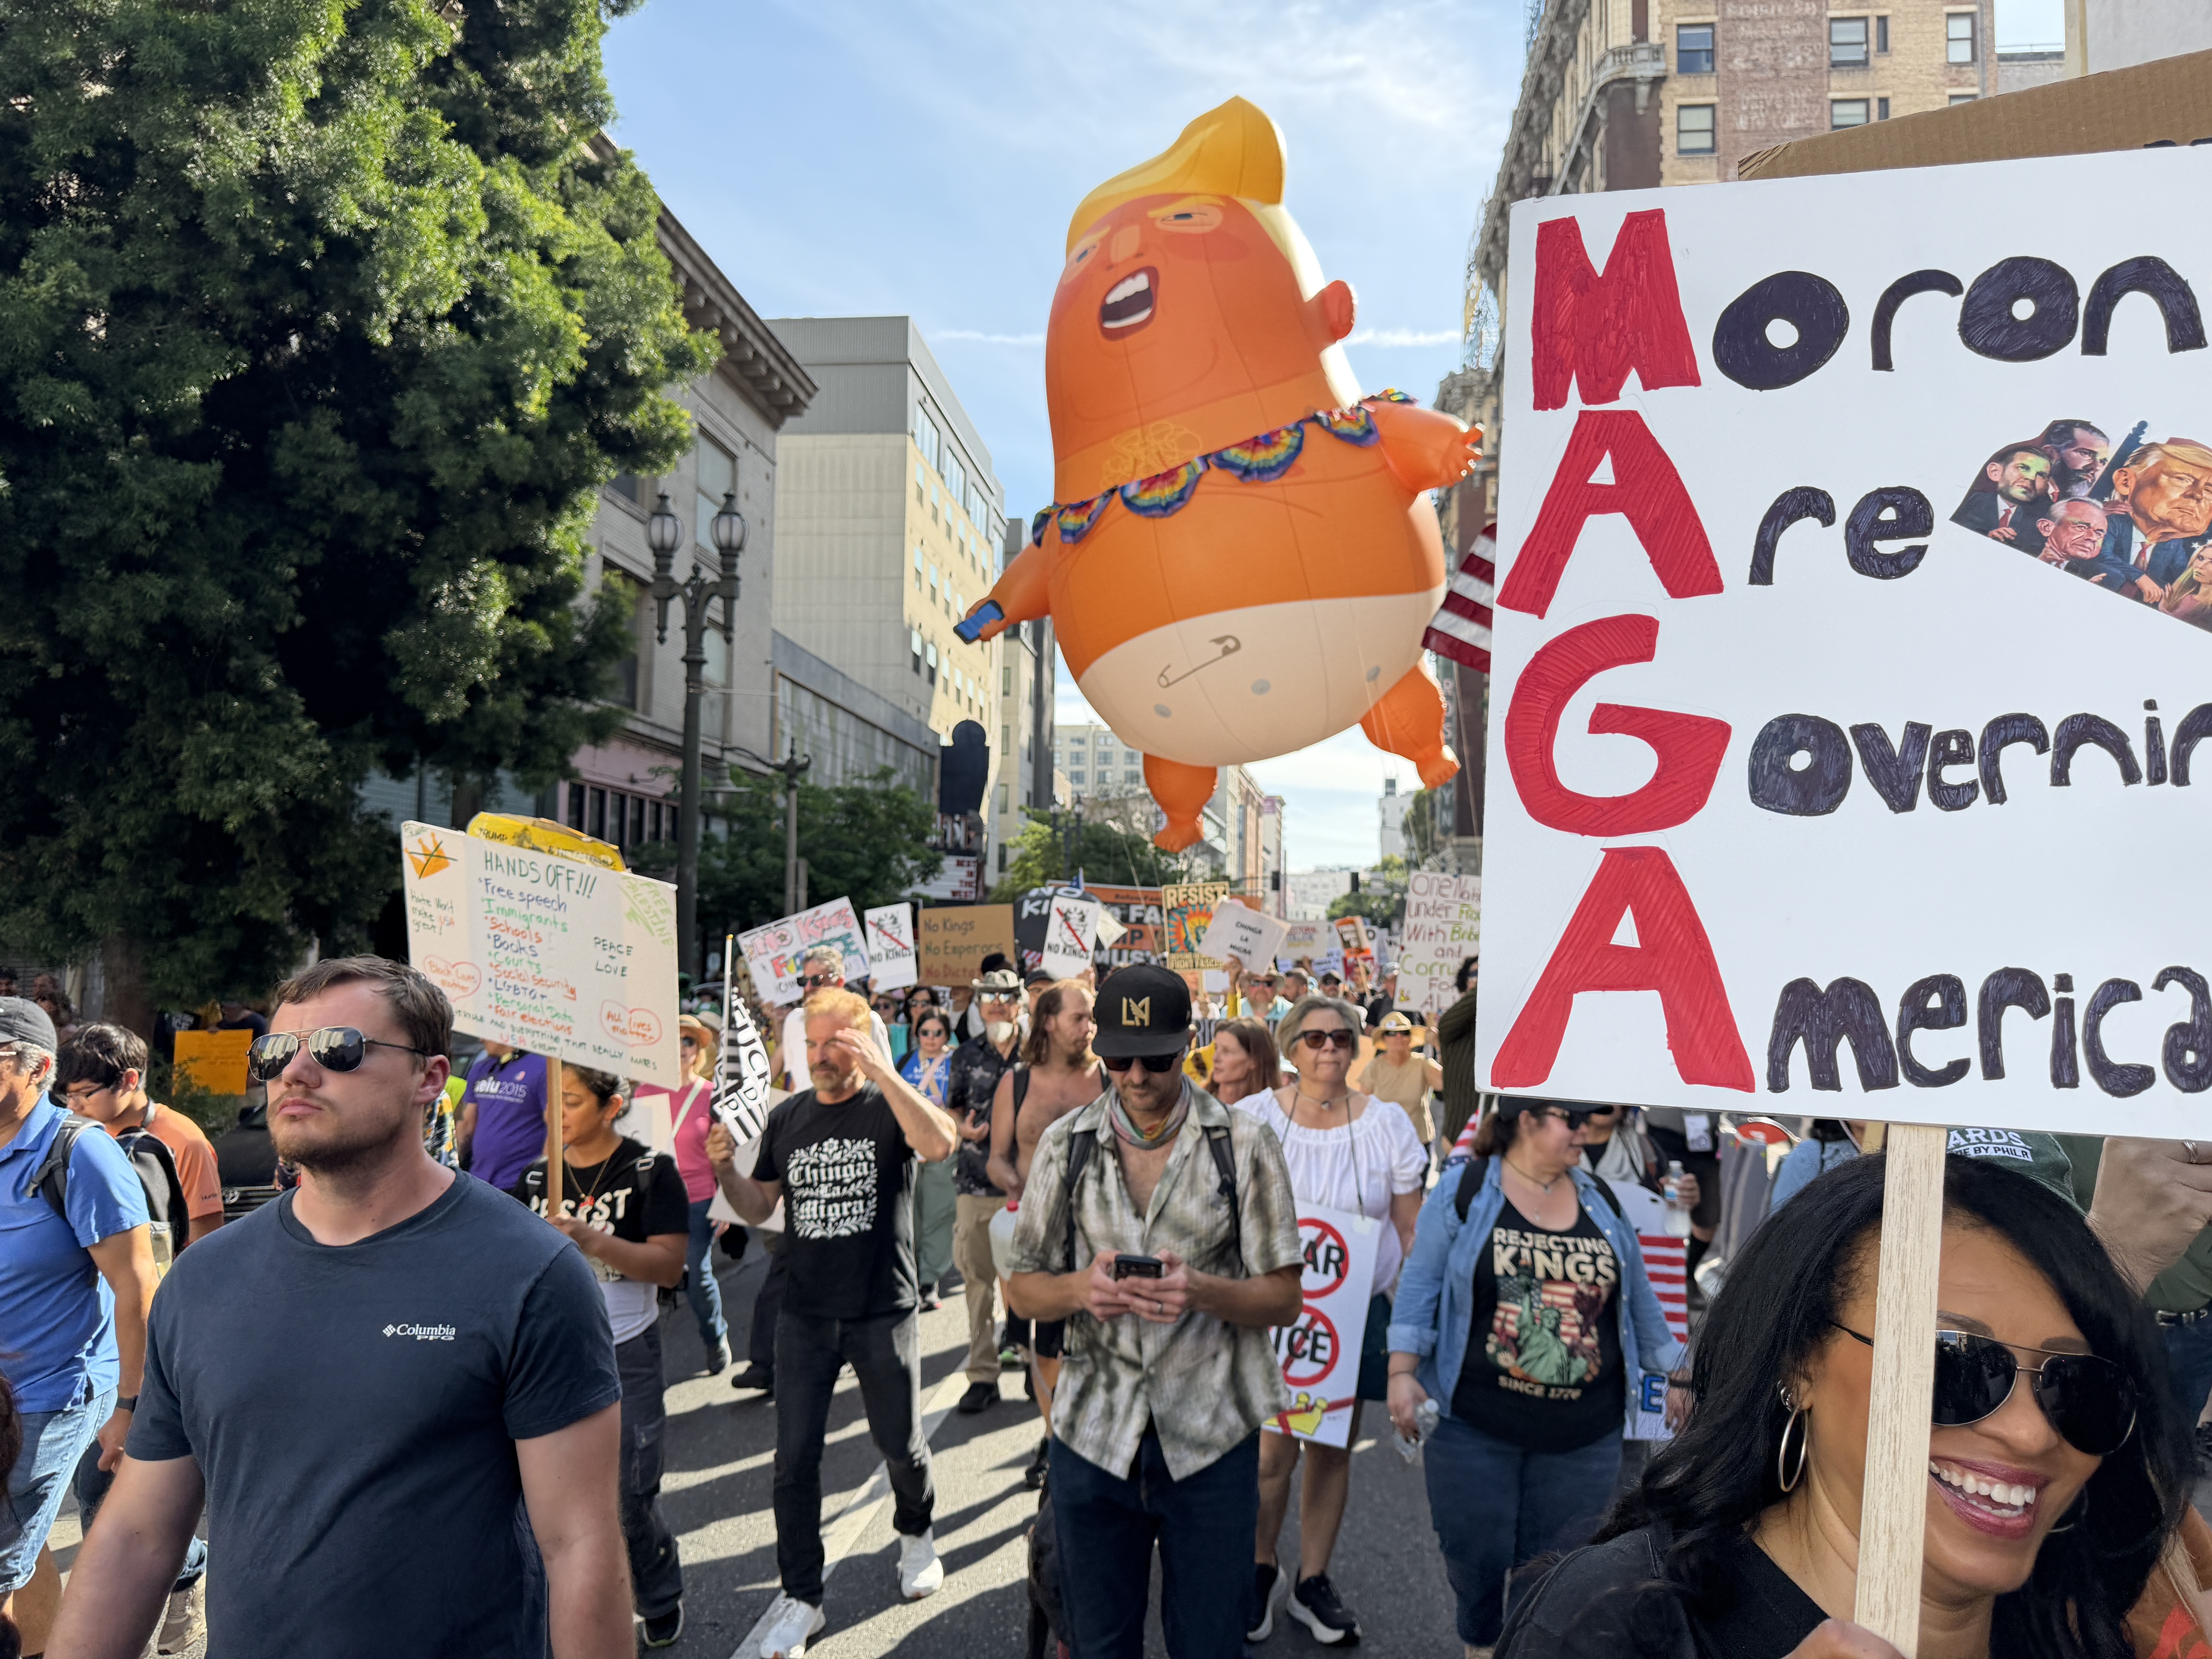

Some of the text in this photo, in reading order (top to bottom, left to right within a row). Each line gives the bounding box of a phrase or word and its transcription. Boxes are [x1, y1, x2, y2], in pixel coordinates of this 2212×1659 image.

[1532, 208, 2207, 410] Moron
[1496, 410, 1934, 619] Are
[485, 850, 541, 883] HANDS
[546, 864, 597, 899] OFF!!!
[484, 877, 567, 913] Free speech
[1166, 886, 1225, 910] RESIST
[1411, 874, 1453, 899] One
[484, 898, 568, 933] Immigrants
[924, 917, 975, 936] No Kings
[489, 916, 543, 944] Schools
[1406, 922, 1446, 943] With
[493, 934, 538, 957] Books
[594, 936, 633, 956] PEACE
[870, 952, 883, 964] NO
[885, 946, 914, 962] KINGS
[925, 939, 1004, 958] No Emperors
[1047, 942, 1090, 960] NO KINGS
[1434, 943, 1462, 959] and
[493, 951, 542, 975] Courts
[595, 960, 628, 977] LOVE
[1492, 845, 2212, 1097] America
[500, 1032, 527, 1046] USA
[1973, 1146, 1989, 1154] BY
[1992, 1146, 2030, 1159] PHILA
[788, 1161, 869, 1188] Chinga
[798, 1199, 865, 1222] Migra
[1492, 1227, 1615, 1257] REJECTING
[1301, 1240, 1346, 1279] AR
[1493, 1243, 1618, 1287] KINGS
[397, 1323, 456, 1336] Columbia
[1498, 1375, 1546, 1397] SINCE
